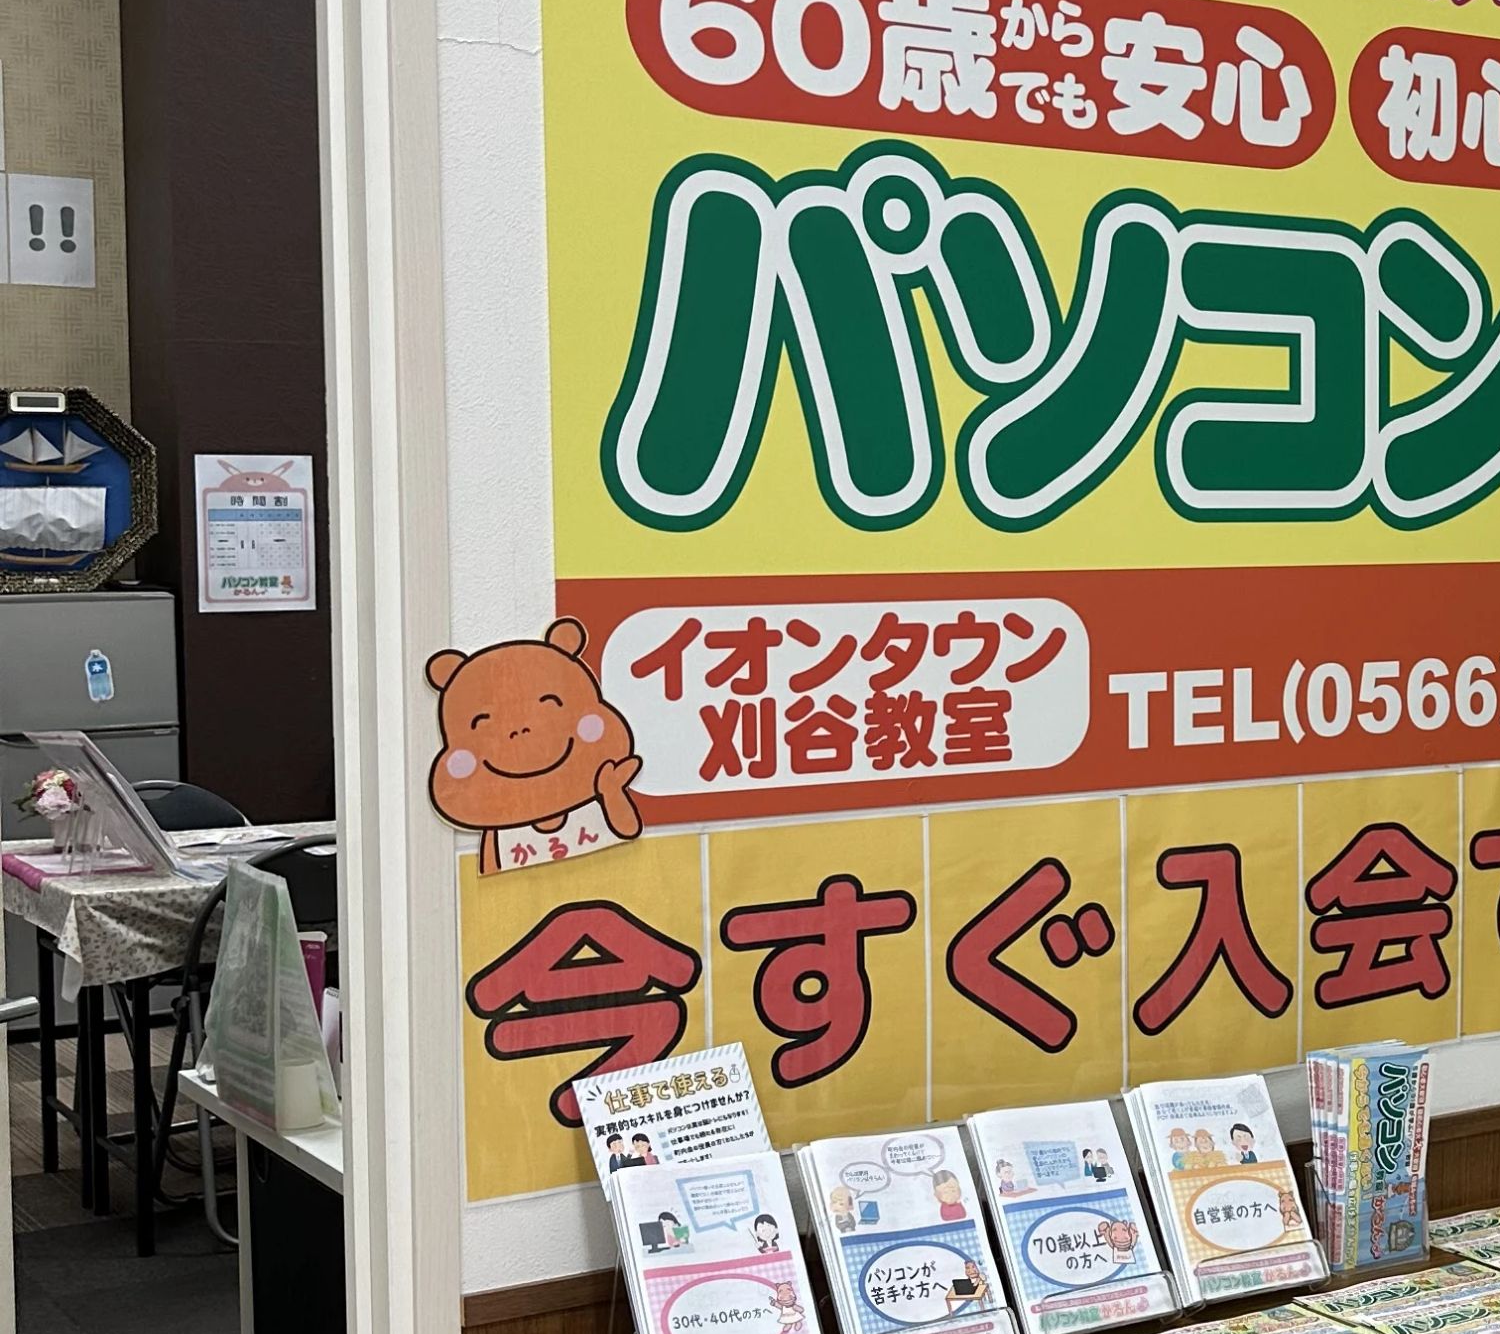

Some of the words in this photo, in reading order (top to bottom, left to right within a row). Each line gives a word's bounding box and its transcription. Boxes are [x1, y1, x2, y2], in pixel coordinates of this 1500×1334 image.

[630, 610, 1067, 702] イオンタウン
[699, 687, 1013, 783] 刈谷教室
[511, 828, 600, 866] かるん
[604, 1067, 729, 1115] 仕事で使える
[1374, 1062, 1410, 1174] パソコン
[1193, 1201, 1280, 1226] 自営業の方へ
[1032, 1231, 1106, 1255] 70歳以上
[867, 1261, 937, 1283] パソコンが
[1065, 1250, 1108, 1271] の方へ
[870, 1280, 948, 1306] 苦手な方へ
